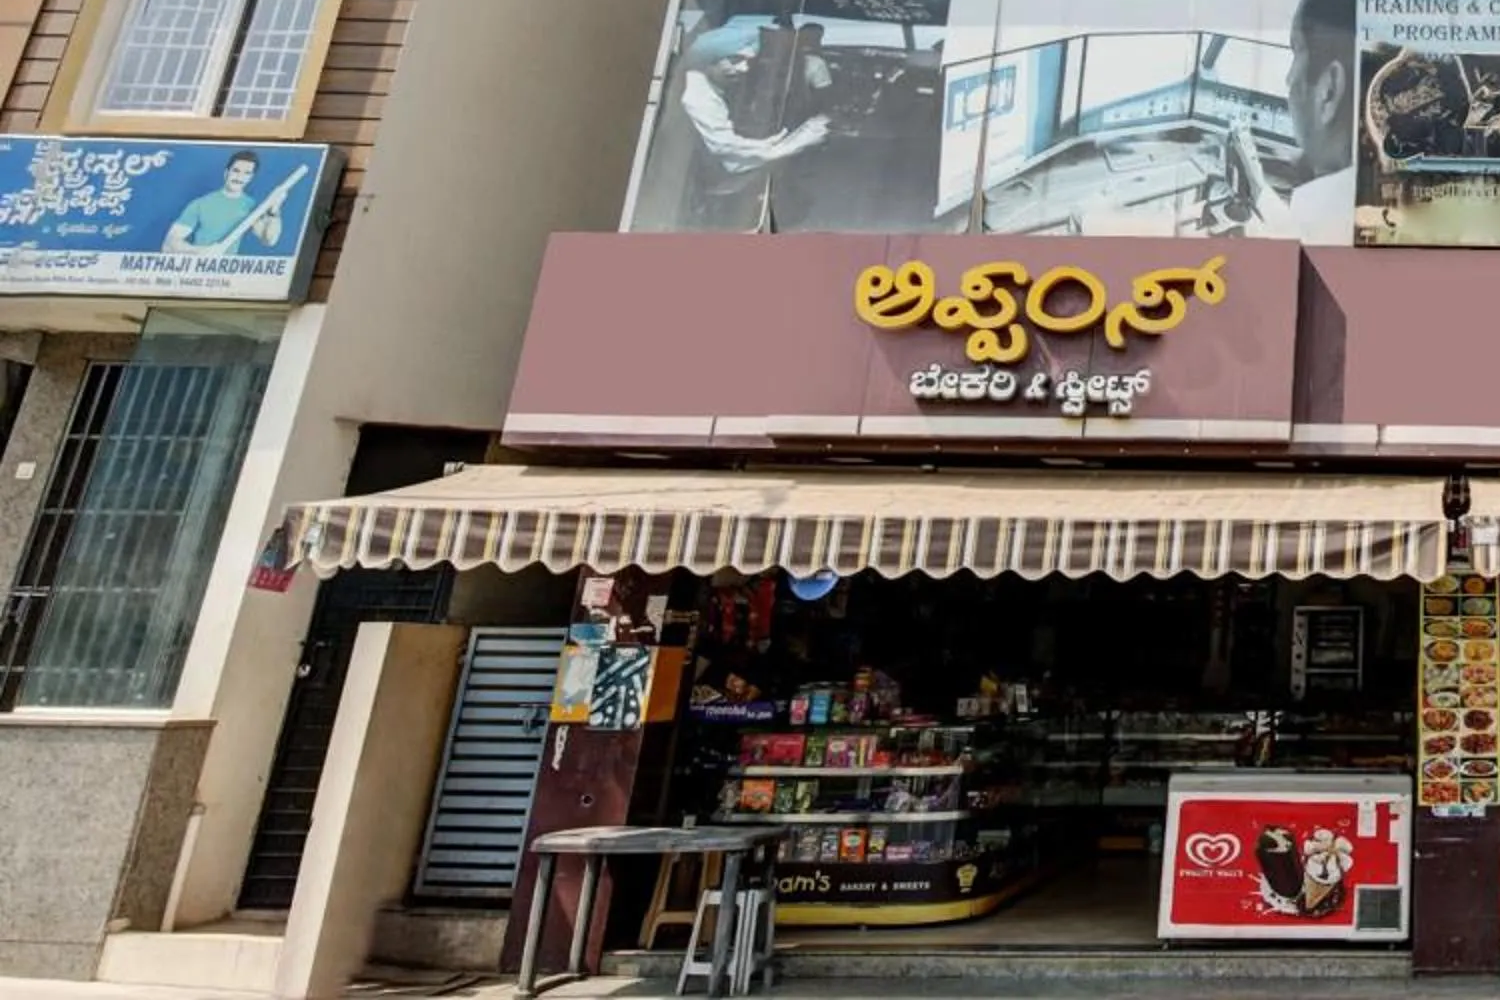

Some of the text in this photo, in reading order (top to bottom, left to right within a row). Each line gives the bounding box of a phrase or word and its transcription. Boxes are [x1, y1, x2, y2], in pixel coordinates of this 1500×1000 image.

[1466, 0, 1481, 15] &
[119, 254, 191, 273] MATHAJI
[194, 257, 287, 276] HARDWARE
[1024, 372, 1050, 400] &
